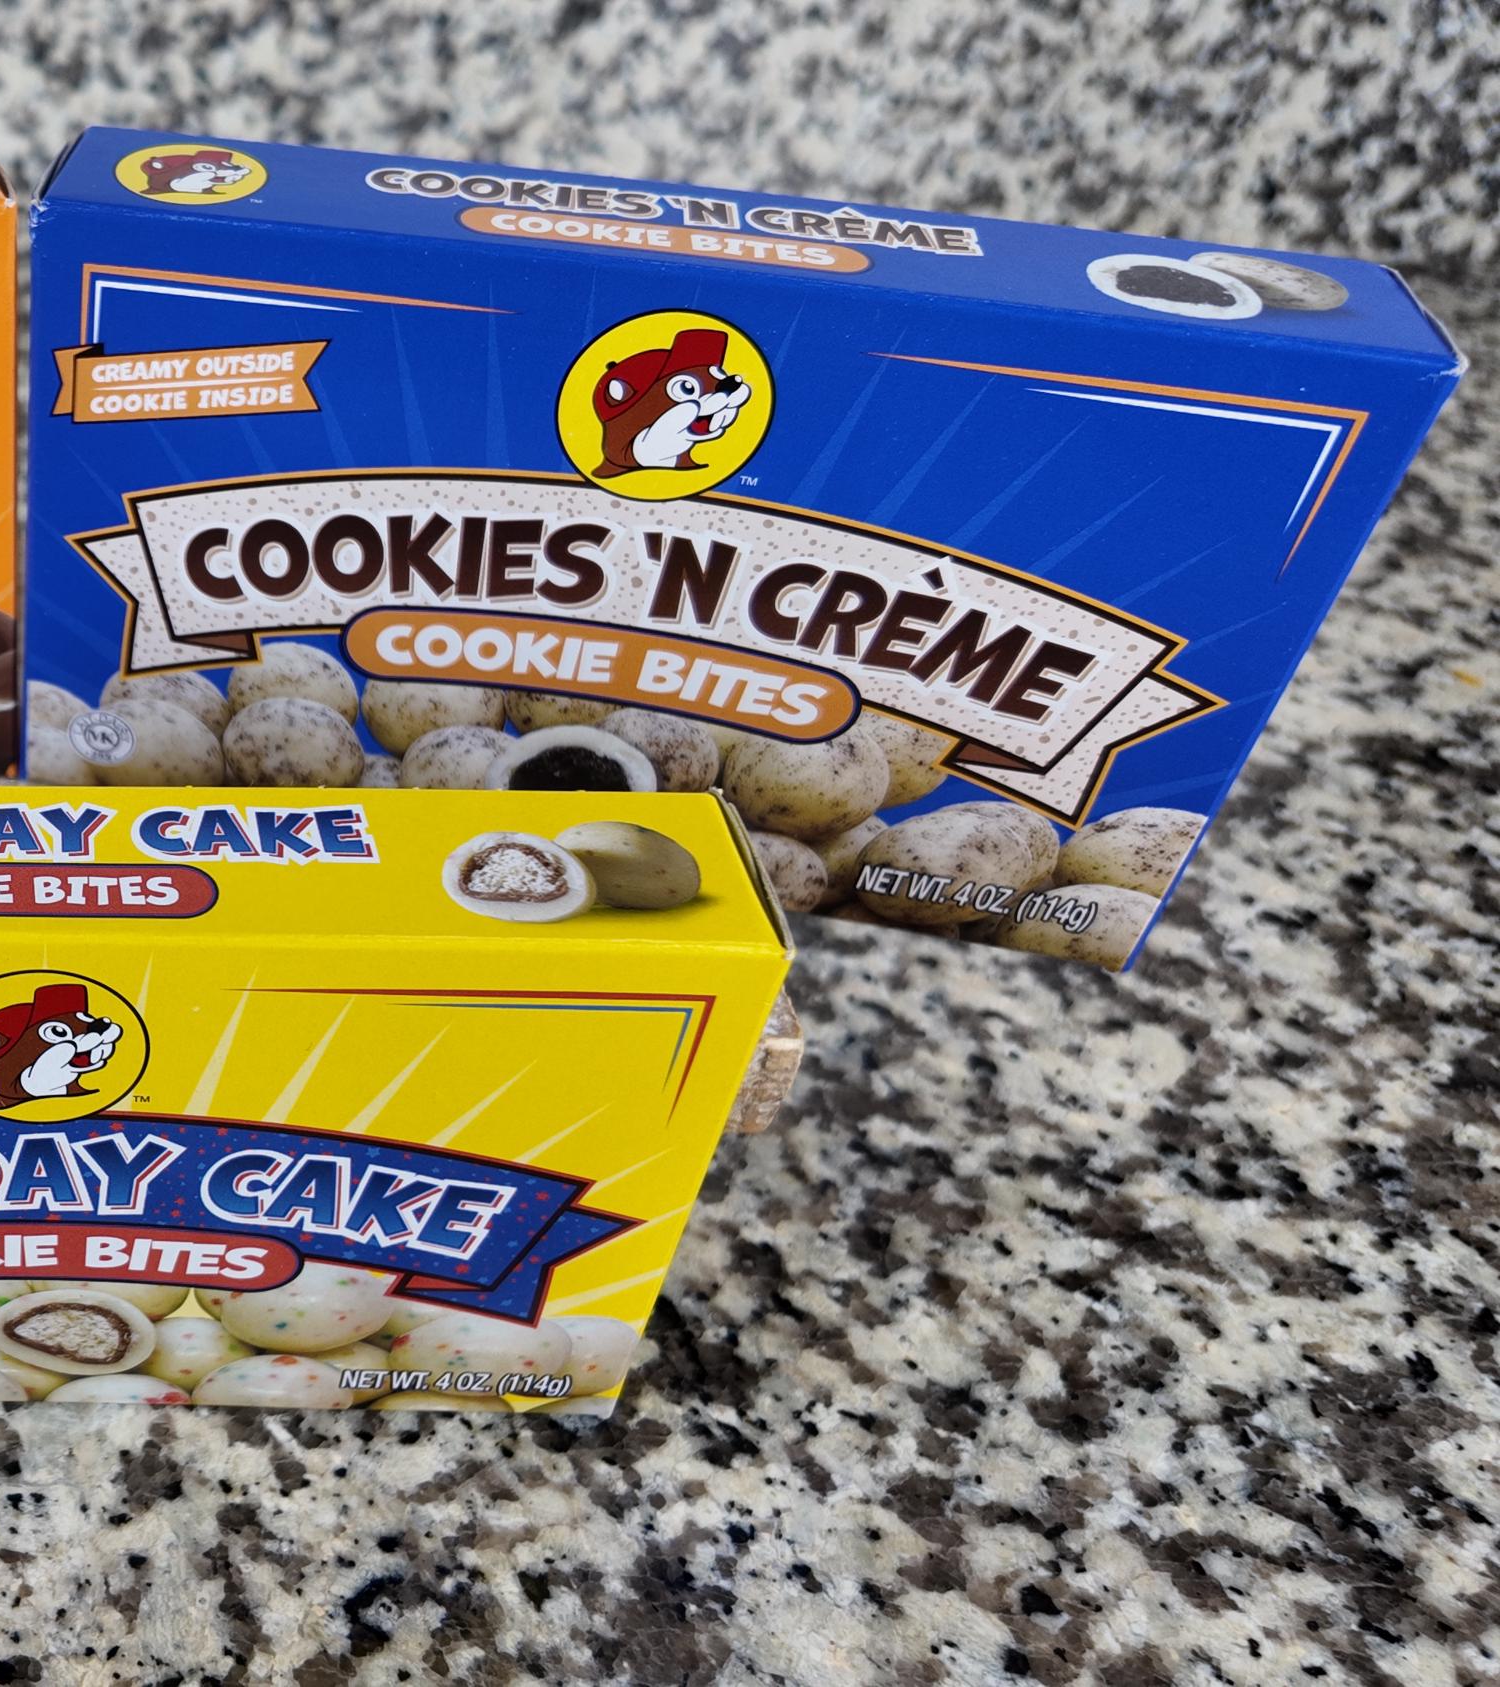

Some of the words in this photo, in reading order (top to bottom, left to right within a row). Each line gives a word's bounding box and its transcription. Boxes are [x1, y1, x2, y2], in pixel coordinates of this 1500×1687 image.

[369, 168, 659, 218] COOKIES
[749, 208, 980, 255] CRÈME
[491, 214, 672, 247] COOKIE
[690, 235, 835, 266] BITES
[92, 359, 189, 384] CREAMY
[196, 352, 294, 377] OUTSIDE
[90, 388, 188, 415] COOKIE
[197, 383, 293, 409] INSIDE
[184, 512, 614, 605] COOKIES
[749, 565, 1095, 723] CRÈME
[375, 625, 619, 683] COOKIE
[636, 650, 827, 726] BITES
[135, 808, 376, 861] CAKE
[33, 876, 179, 905] BITES
[856, 865, 910, 895] NET
[908, 873, 951, 904] WT.
[953, 882, 975, 907] 4
[974, 884, 1015, 914] OZ.
[1016, 893, 1098, 932] (114g)
[204, 1151, 511, 1256] CAKE
[85, 1236, 268, 1279] BITES
[340, 1370, 387, 1389] NET
[392, 1371, 429, 1390] WT.
[435, 1372, 453, 1391] 4
[456, 1373, 491, 1391] OZ.
[497, 1373, 571, 1396] (114g)
